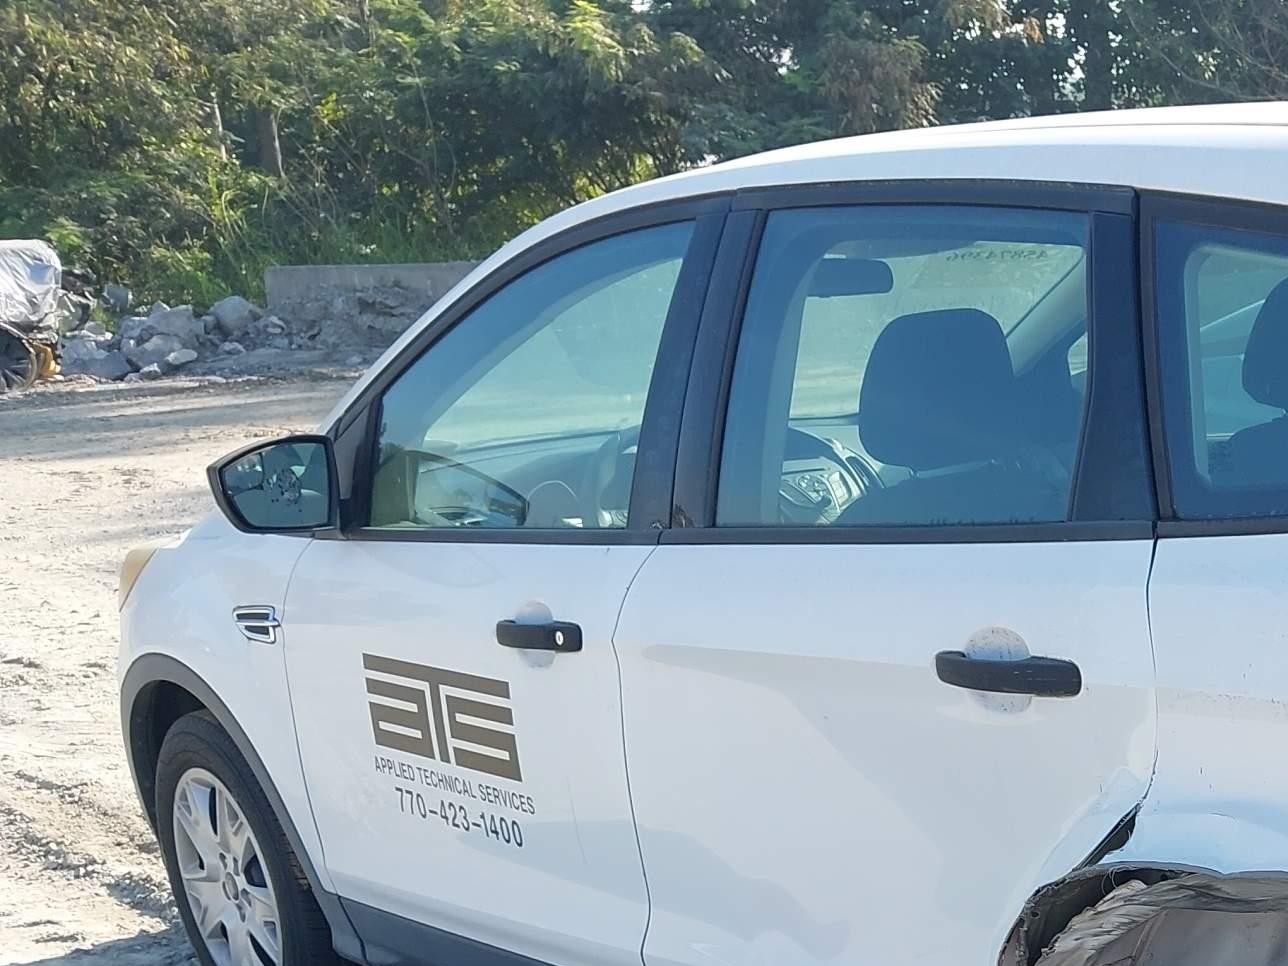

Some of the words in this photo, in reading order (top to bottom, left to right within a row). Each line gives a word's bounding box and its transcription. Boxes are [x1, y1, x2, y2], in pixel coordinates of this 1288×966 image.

[374, 756, 416, 782] APPLIED
[416, 766, 477, 800] TECHNICAL
[478, 783, 536, 816] SERVICES
[394, 786, 524, 848] 770-423-1400
